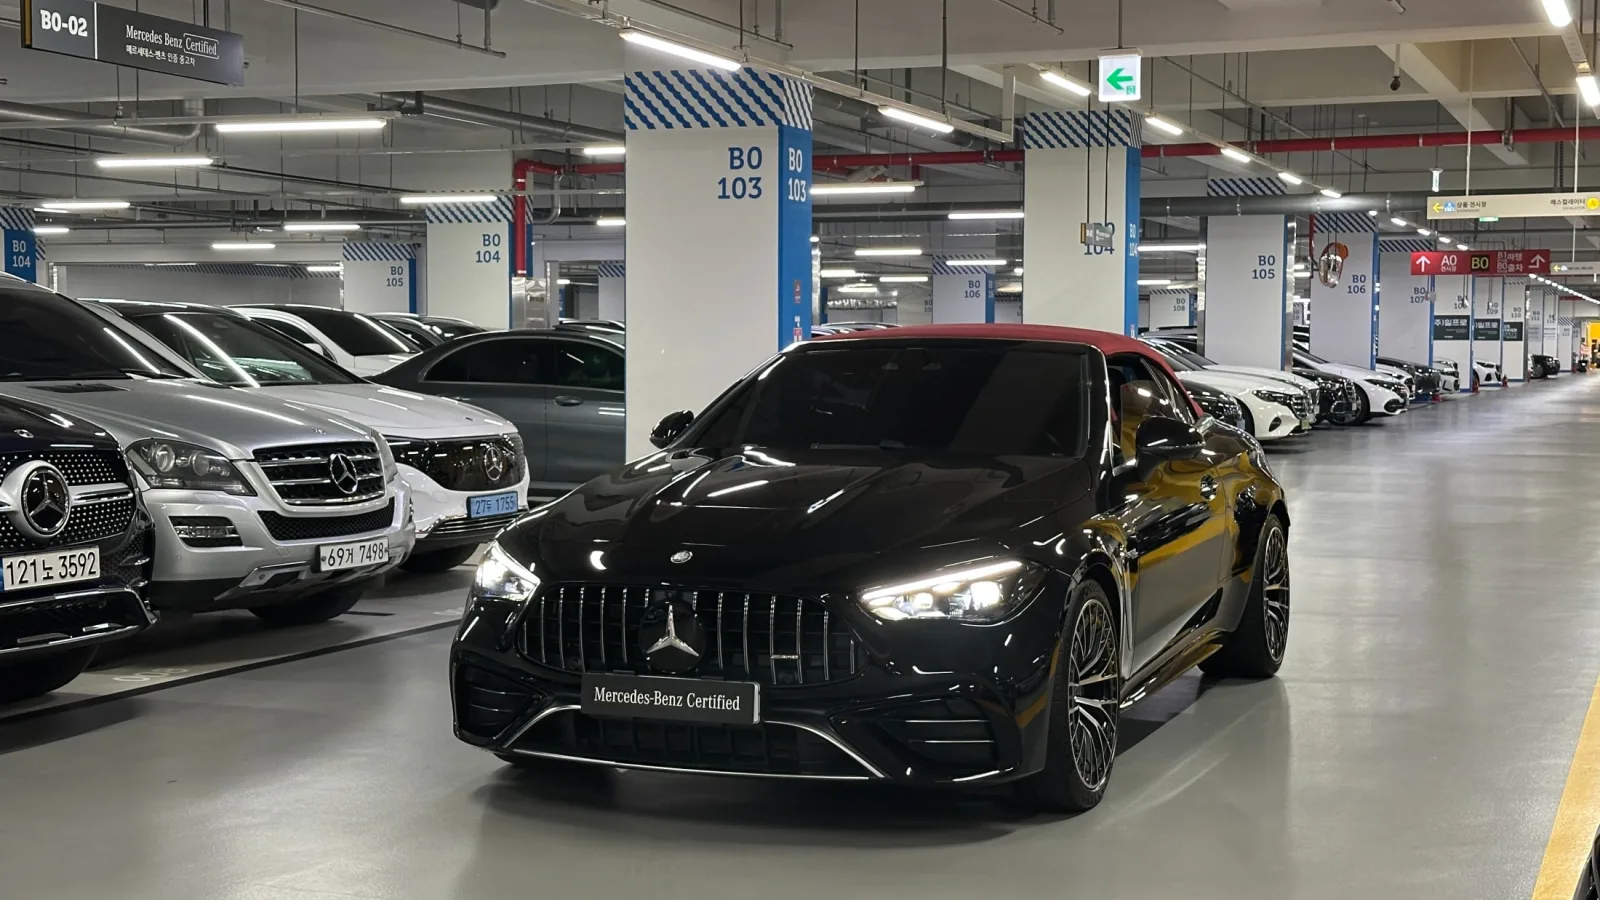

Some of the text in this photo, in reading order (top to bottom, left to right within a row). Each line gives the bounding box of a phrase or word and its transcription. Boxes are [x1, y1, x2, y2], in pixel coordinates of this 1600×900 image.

[40, 9, 88, 37] B0-02
[126, 24, 217, 55] Mercedes Benz Certified
[125, 44, 196, 67] 메르세데스-벤츠 인증 중고차
[728, 146, 763, 170] B0
[788, 147, 803, 173] B0
[717, 177, 763, 200] 103
[788, 178, 807, 203] 103
[12, 239, 27, 253] B0
[482, 233, 501, 247] B0
[12, 255, 31, 268] 104
[475, 250, 501, 263] 104
[1258, 255, 1276, 266] B0
[1441, 254, 1457, 266] A0
[1471, 257, 1489, 269] B0
[390, 266, 404, 276] B0
[1252, 268, 1276, 280] 105
[386, 277, 404, 287] 105
[968, 280, 981, 289] B0
[1352, 274, 1367, 284] B0
[964, 290, 981, 299] 106
[1347, 285, 1367, 294] 106
[475, 496, 515, 515] 27두 1755
[359, 542, 385, 563] 7498
[6, 551, 97, 586] 121노 3592
[594, 686, 741, 711] Mercedes-Benz Certified
